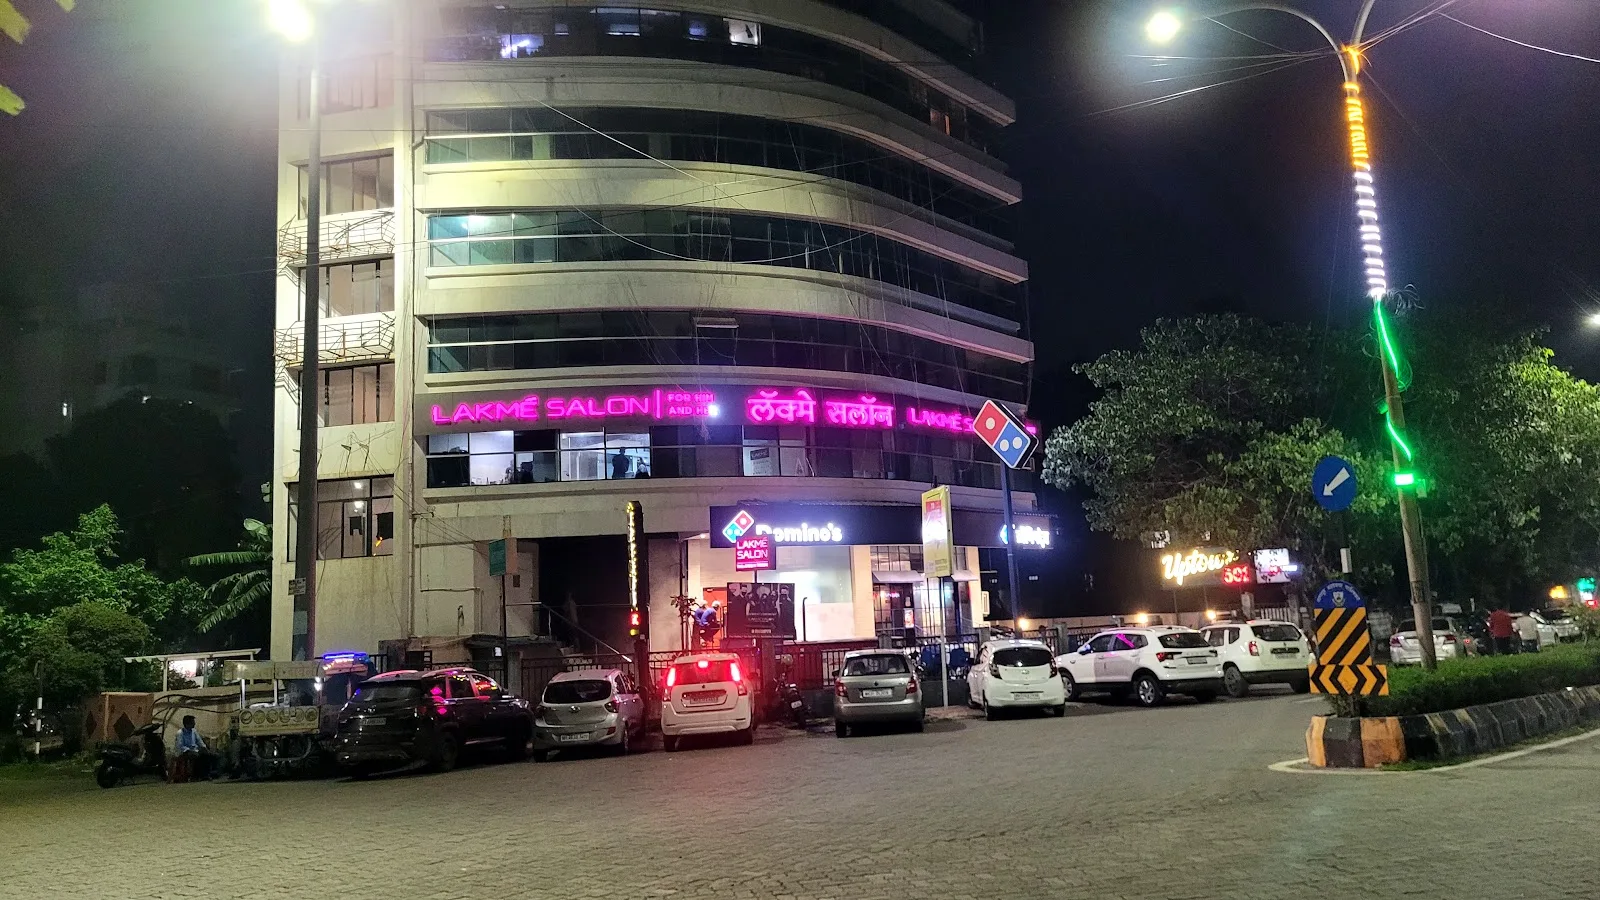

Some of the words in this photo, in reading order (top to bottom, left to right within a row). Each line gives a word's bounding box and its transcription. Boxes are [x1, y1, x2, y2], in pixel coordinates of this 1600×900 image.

[667, 393, 691, 403] FOR
[694, 393, 714, 403] HIM
[432, 396, 539, 423] LAKMÉ
[546, 397, 650, 418] SALON
[668, 406, 692, 415] AND
[755, 522, 843, 543] Domino's
[736, 537, 768, 550] LAKMÉ
[736, 549, 769, 560] SALON
